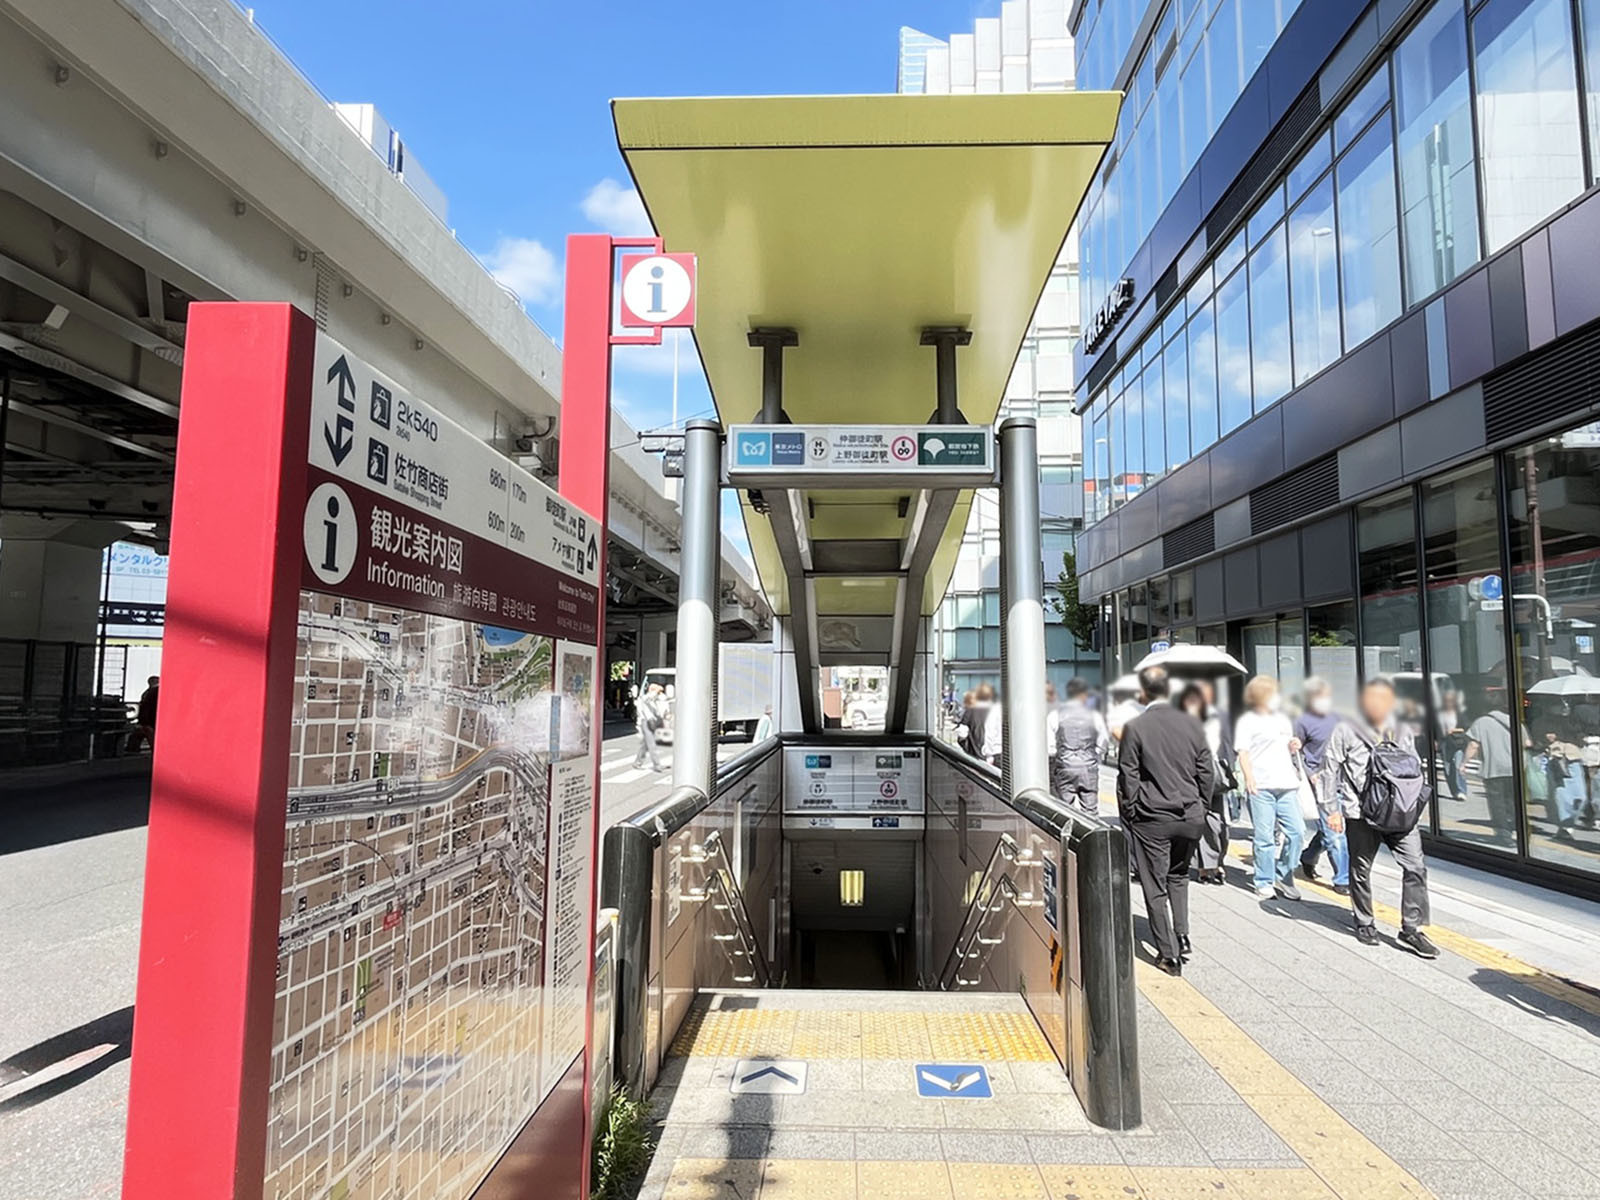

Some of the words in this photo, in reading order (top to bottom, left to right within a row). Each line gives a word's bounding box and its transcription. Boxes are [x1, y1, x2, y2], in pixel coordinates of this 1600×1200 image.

[397, 401, 439, 442] 2k540
[814, 448, 825, 456] 17
[898, 448, 910, 456] 09
[394, 452, 449, 500] 佐竹商店街
[370, 505, 464, 576] 観光案内図
[367, 557, 446, 599] Information
